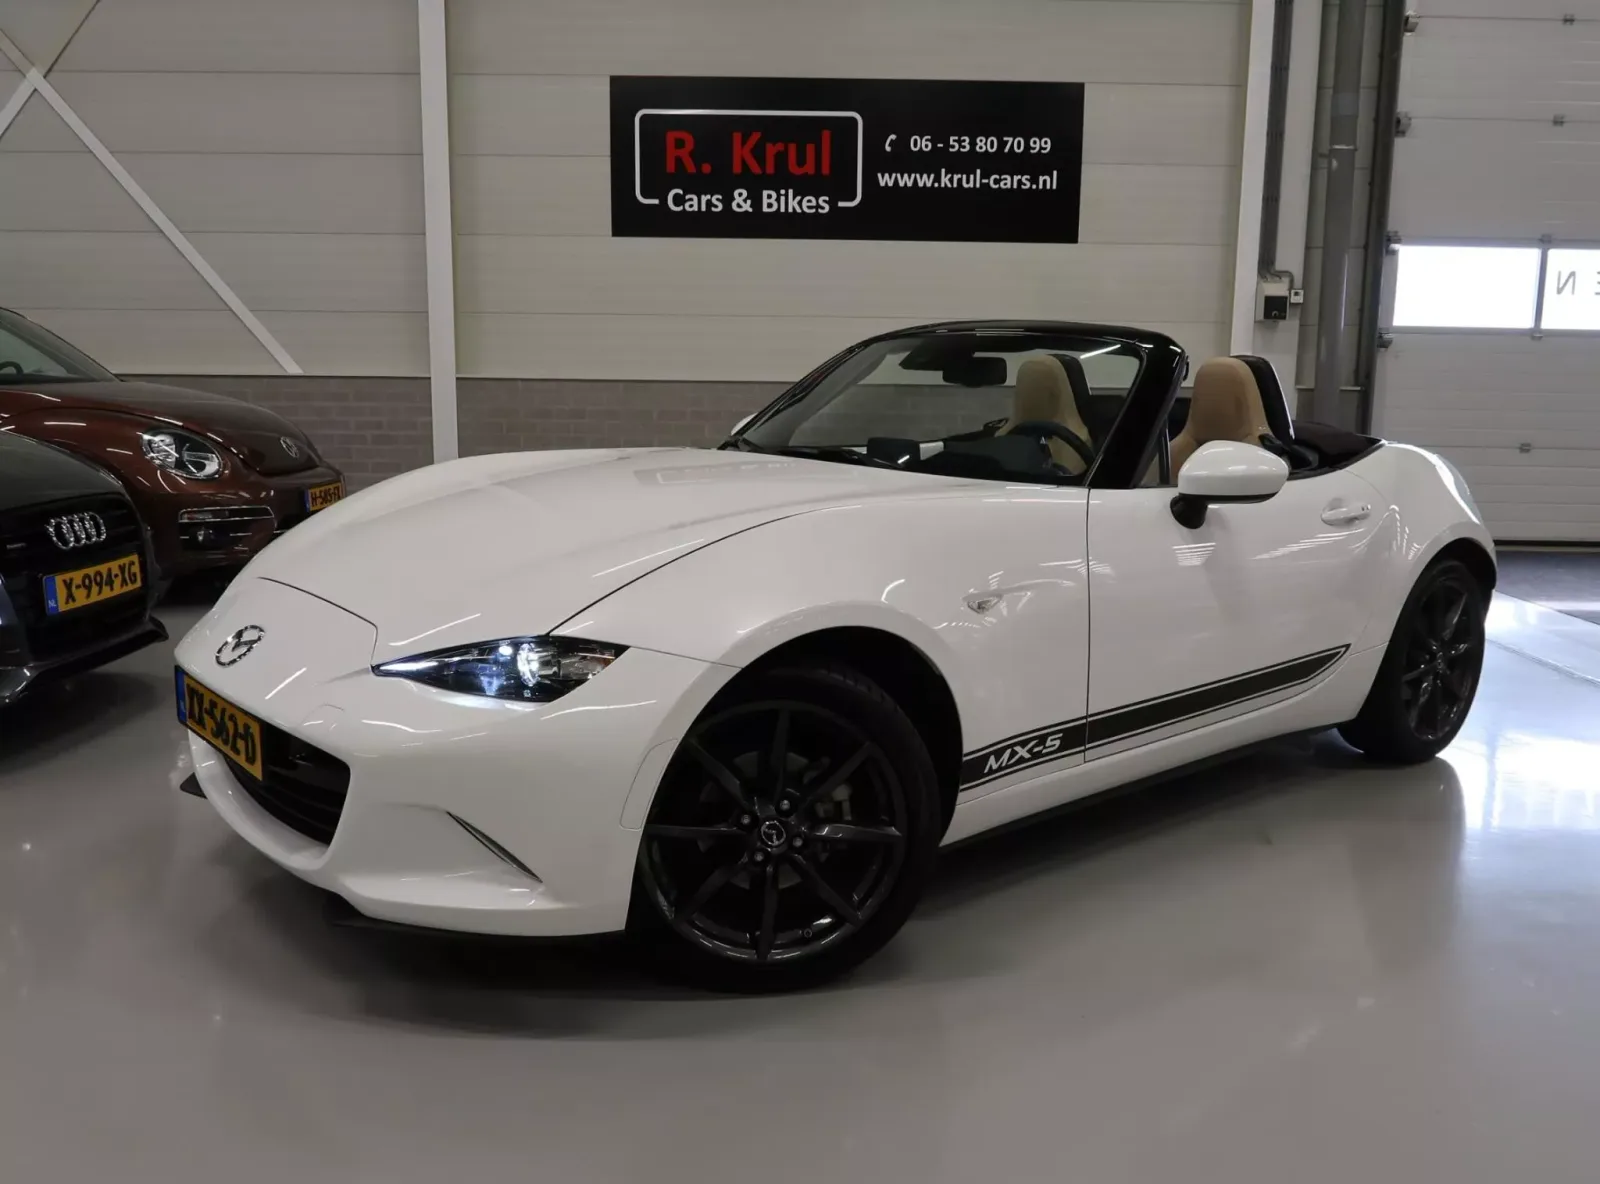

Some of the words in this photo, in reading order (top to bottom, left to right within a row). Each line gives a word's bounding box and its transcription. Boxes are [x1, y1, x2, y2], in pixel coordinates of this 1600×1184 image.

[665, 130, 712, 174] R.
[732, 129, 832, 176] Krul
[909, 135, 933, 152] 06
[949, 135, 971, 152] 53
[975, 136, 998, 153] 80
[1003, 136, 1025, 153] 70
[1029, 137, 1052, 154] 99
[877, 168, 1058, 190] www.krul-cars.nl
[667, 188, 724, 212] Cars
[731, 188, 754, 212] &
[762, 188, 831, 214] Bikes
[62, 560, 138, 606] X-994-XG
[983, 733, 1064, 774] MX-5
